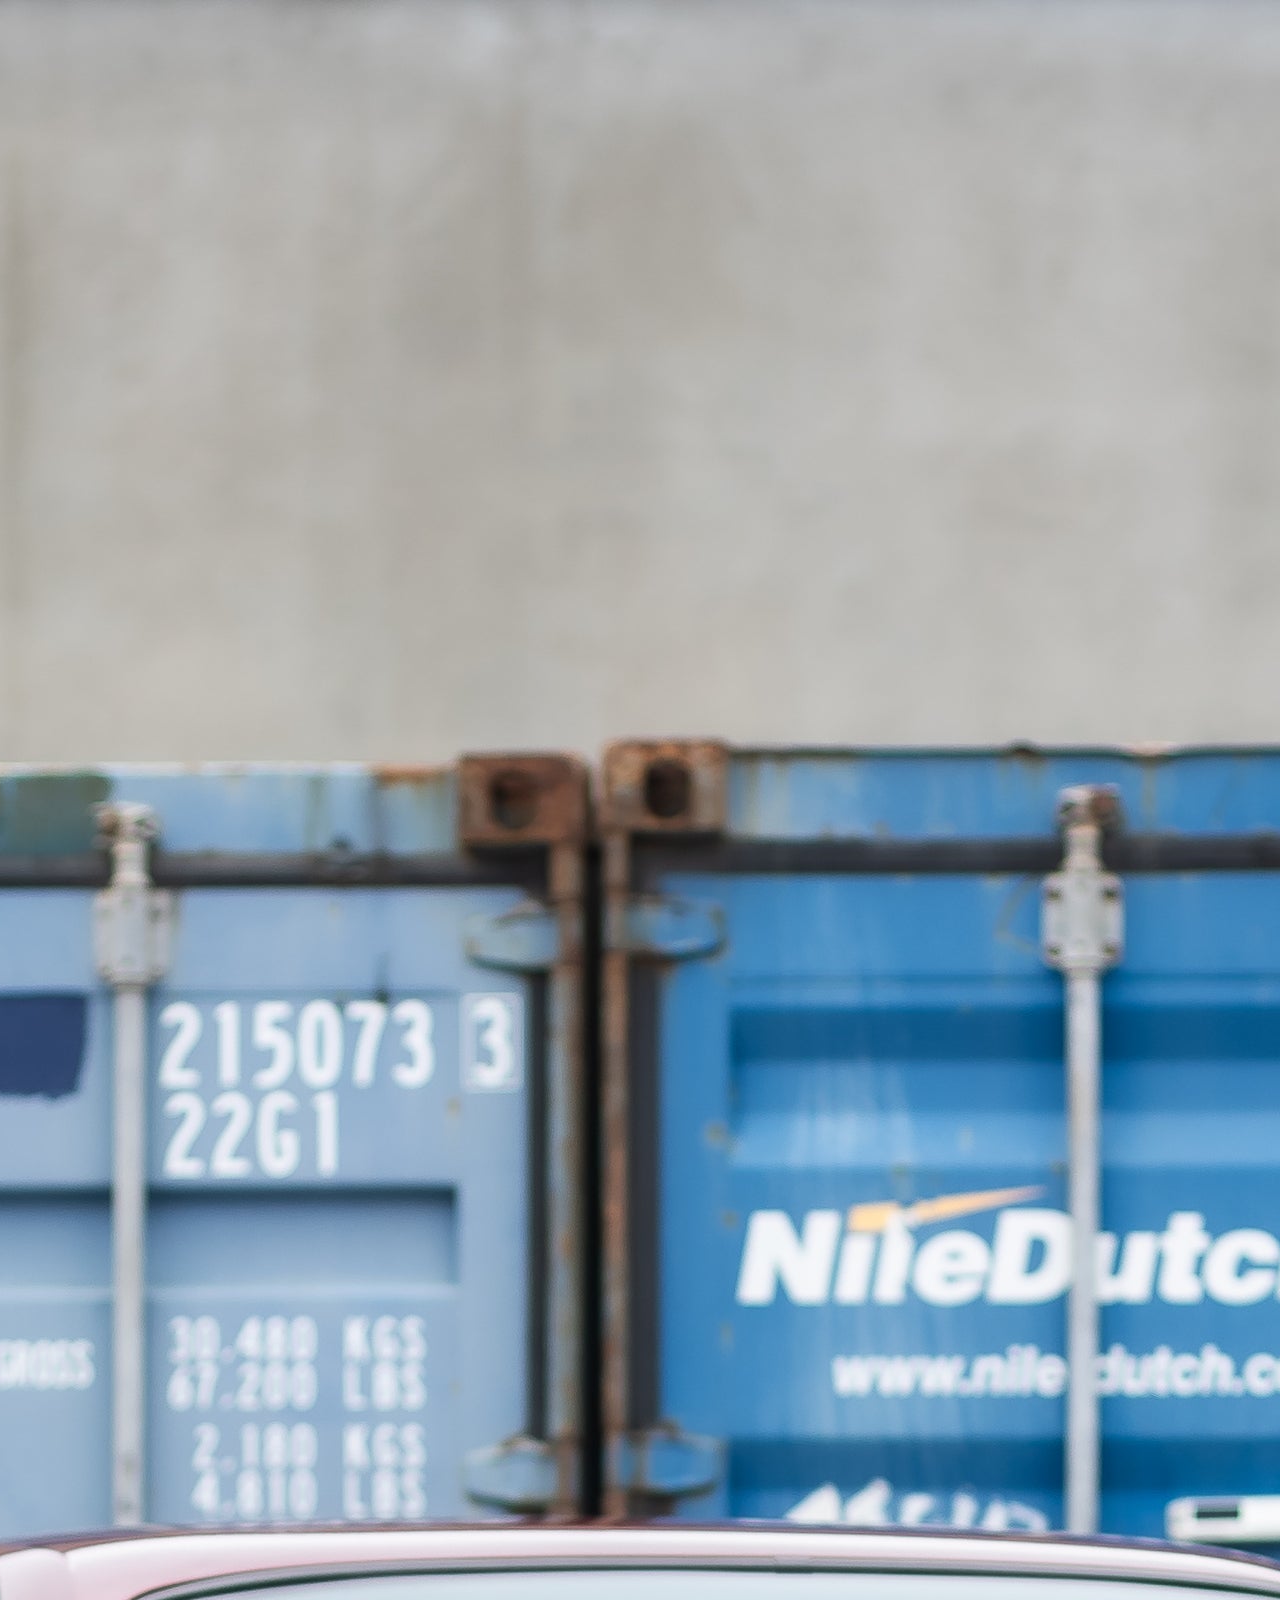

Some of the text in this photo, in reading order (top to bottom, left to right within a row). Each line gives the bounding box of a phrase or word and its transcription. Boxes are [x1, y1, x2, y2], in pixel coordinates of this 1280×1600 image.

[160, 1000, 516, 1091] 215073 3
[163, 1091, 341, 1178] 22G1
[342, 1315, 428, 1362] KGS
[342, 1361, 428, 1412] LBS
[342, 1423, 428, 1472] KGS
[342, 1469, 428, 1521] LBS
